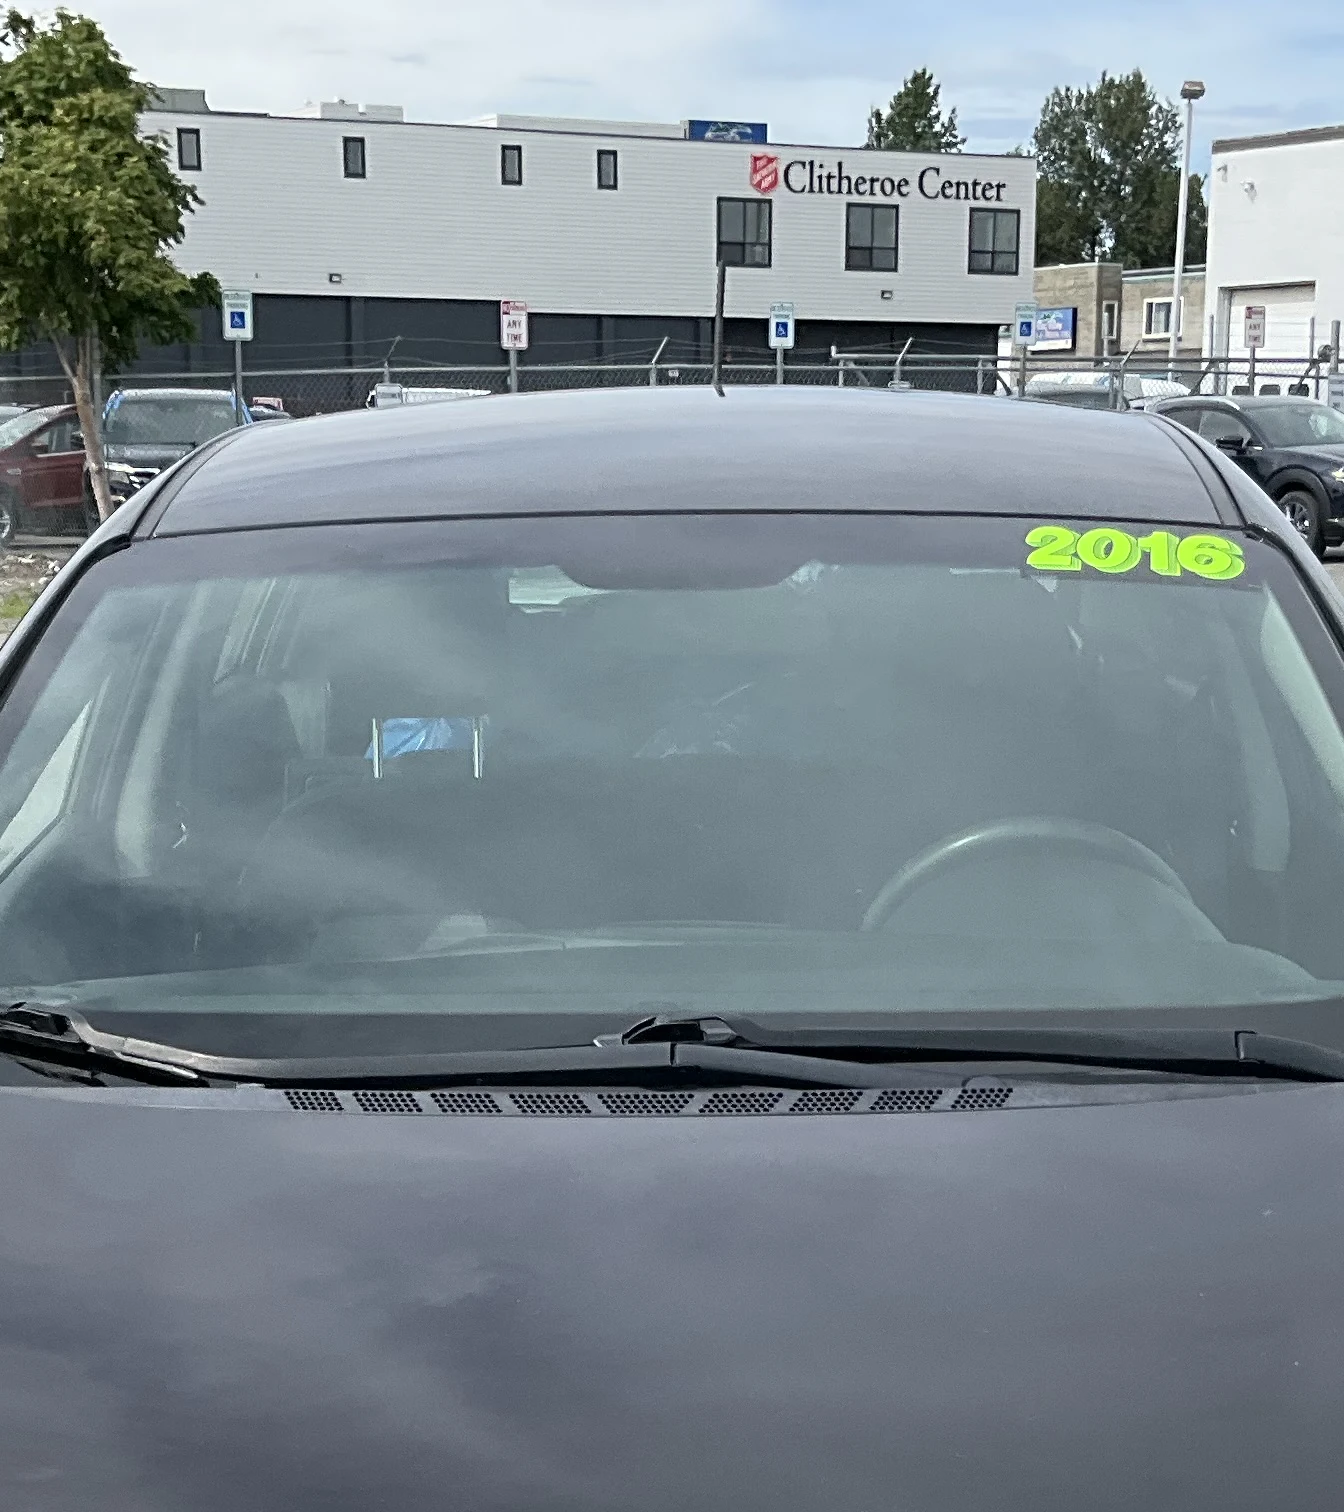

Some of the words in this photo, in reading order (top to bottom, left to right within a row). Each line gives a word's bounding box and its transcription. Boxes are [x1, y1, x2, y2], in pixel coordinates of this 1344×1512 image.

[783, 160, 910, 197] Clitheroe
[918, 167, 1007, 201] Center
[507, 319, 521, 329] ANY
[506, 333, 523, 342] TIME
[1025, 525, 1246, 580] 2016
